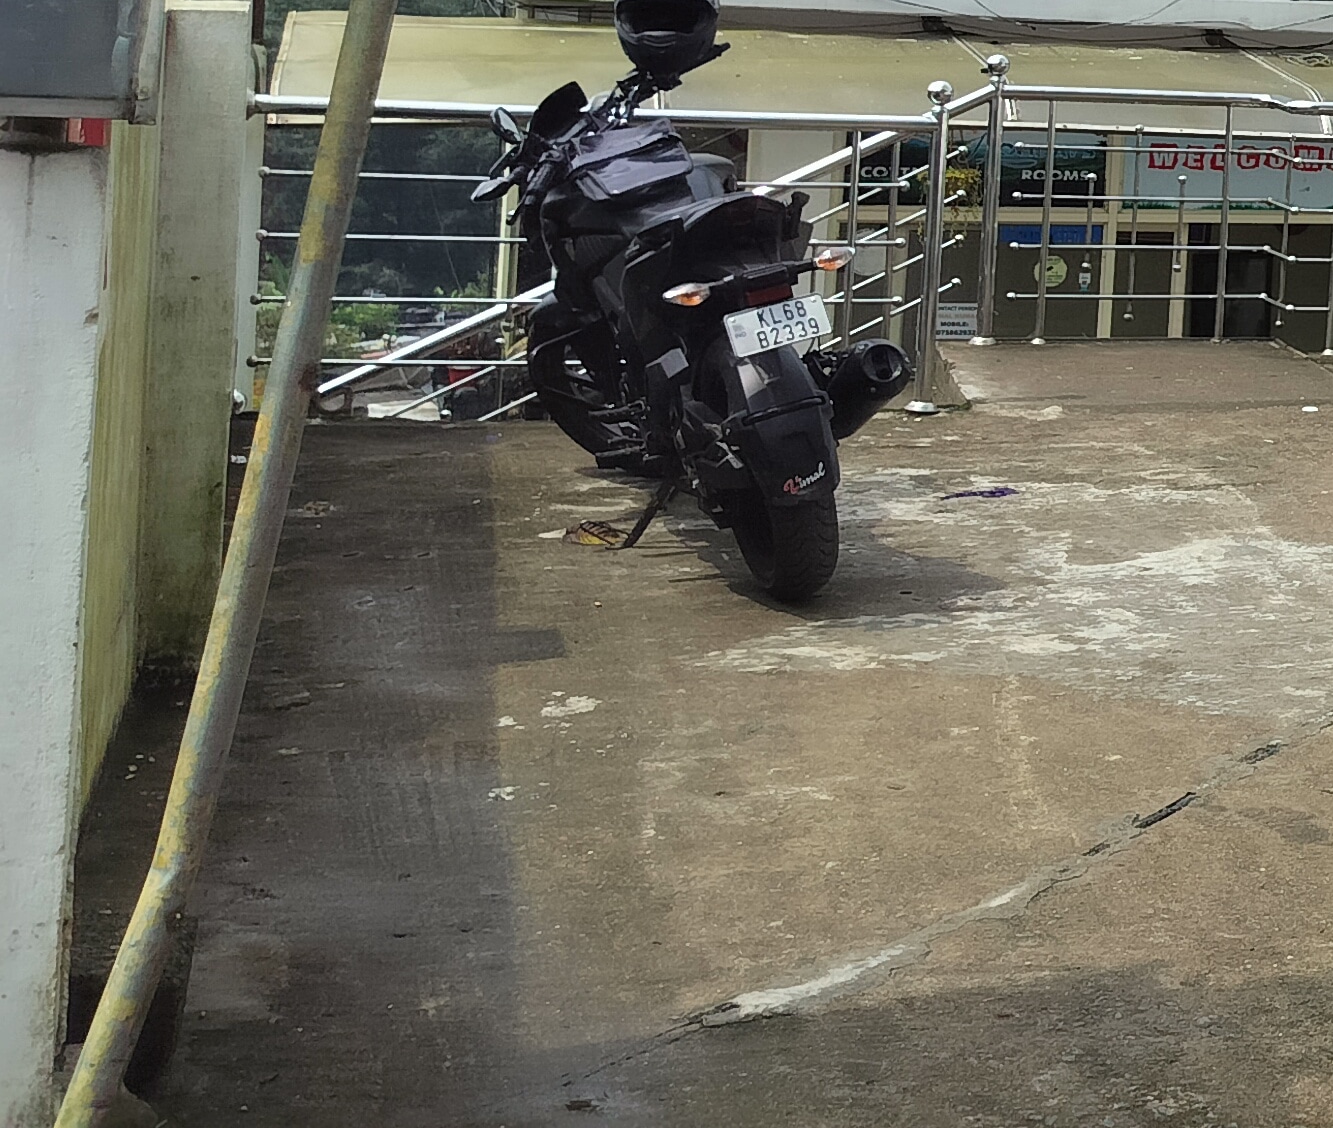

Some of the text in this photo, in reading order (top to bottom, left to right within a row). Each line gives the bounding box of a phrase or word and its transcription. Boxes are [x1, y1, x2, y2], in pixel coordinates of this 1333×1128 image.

[1021, 169, 1090, 181] ROOMS
[756, 300, 807, 329] KL68
[756, 317, 820, 349] B2339
